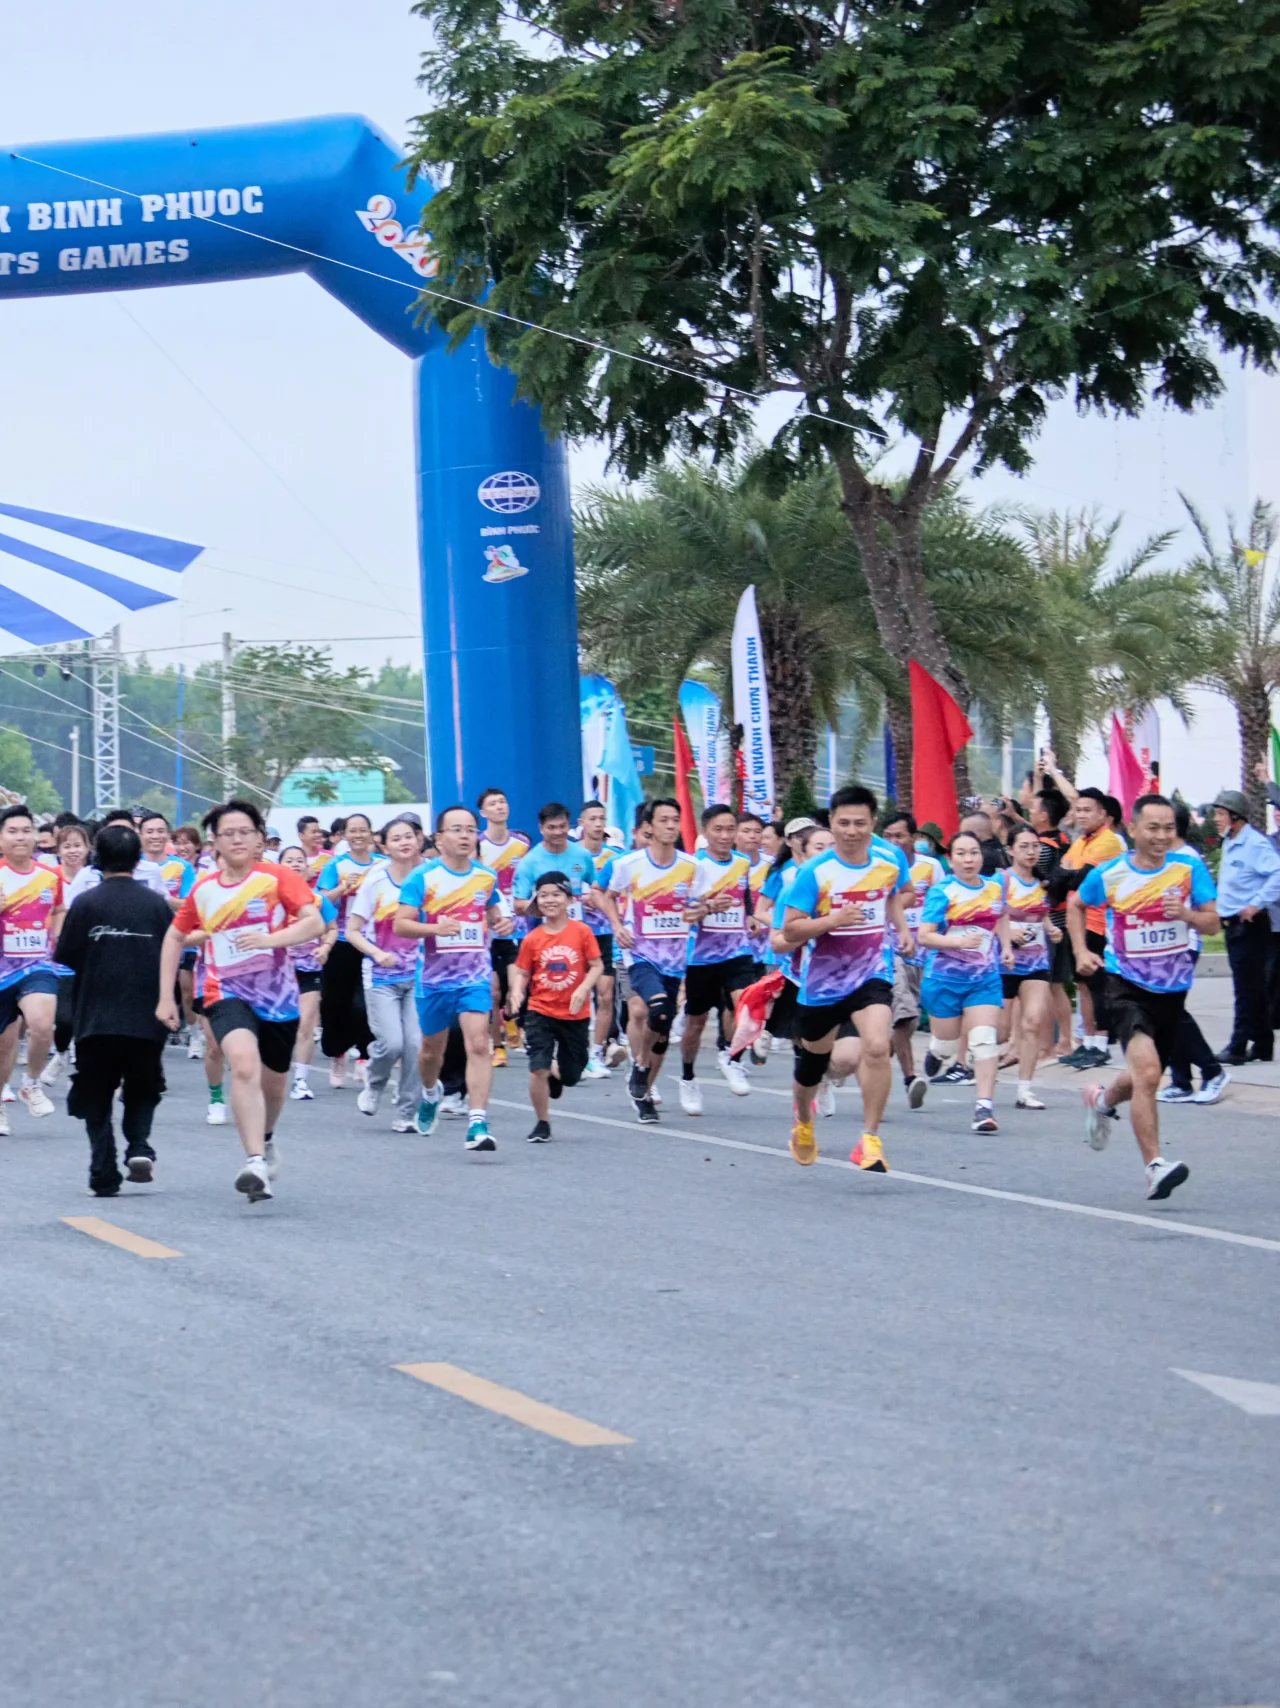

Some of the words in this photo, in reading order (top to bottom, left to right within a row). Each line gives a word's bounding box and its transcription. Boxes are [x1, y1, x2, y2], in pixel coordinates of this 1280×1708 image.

[27, 198, 123, 231] BINH
[141, 185, 264, 223] PHUOC
[58, 238, 190, 272] GAMES
[652, 917, 680, 928] 1232
[714, 912, 740, 923] 1073
[15, 935, 41, 947] 1194
[1139, 927, 1177, 945] 1075
